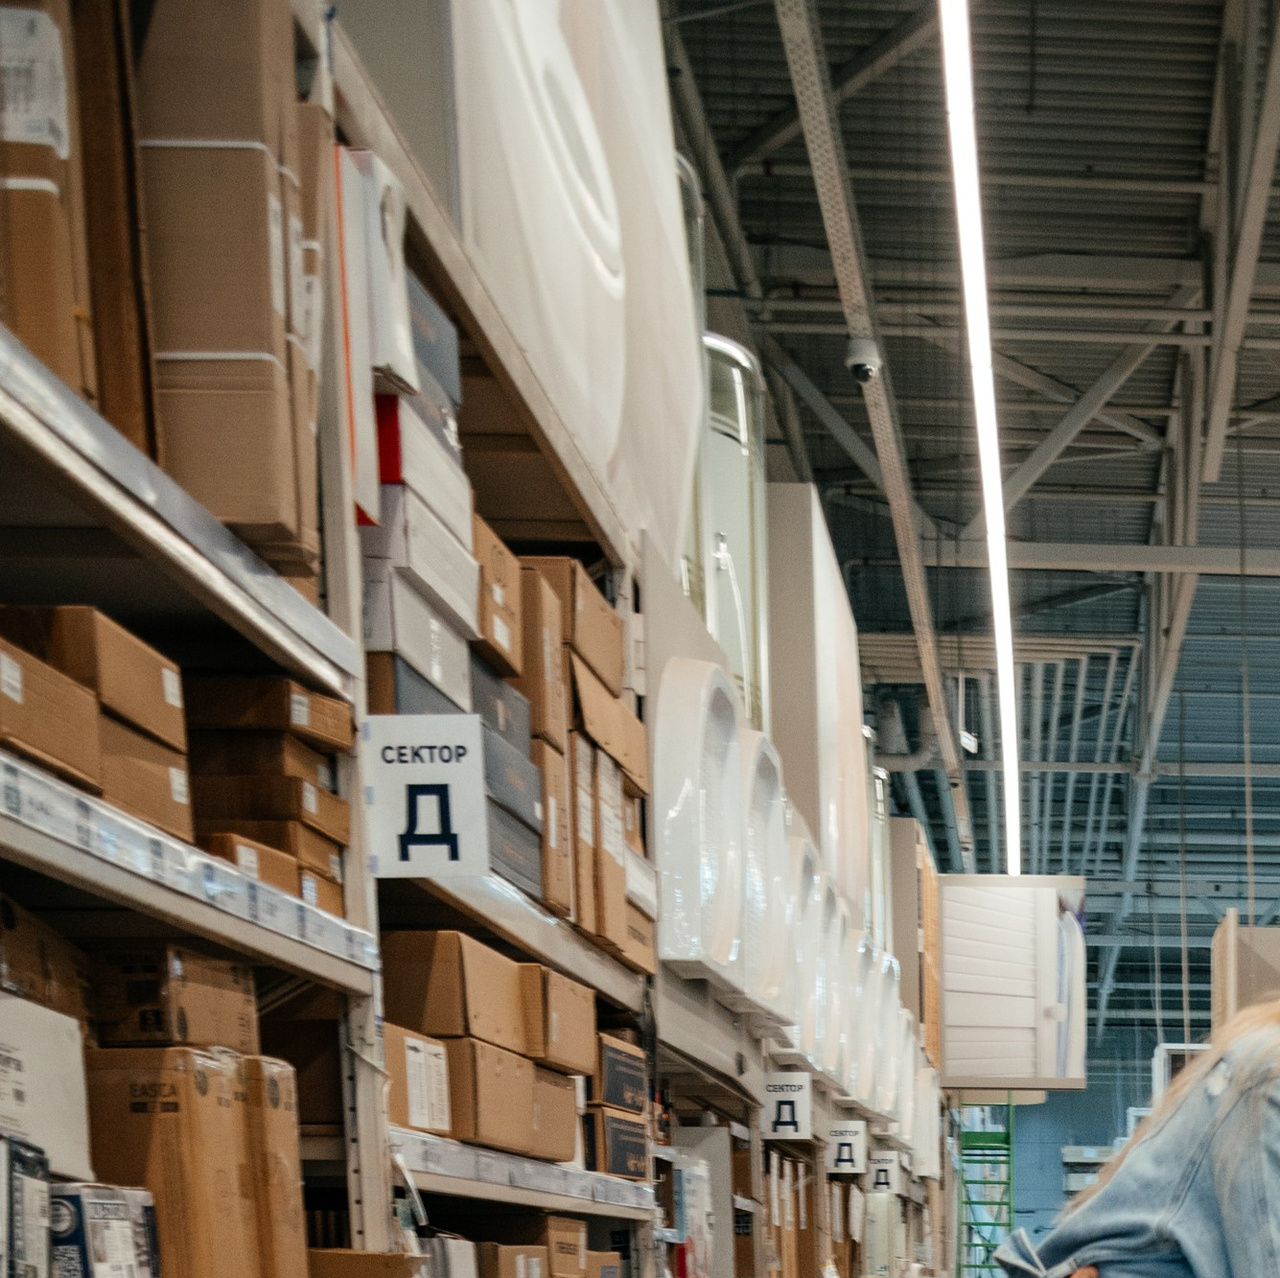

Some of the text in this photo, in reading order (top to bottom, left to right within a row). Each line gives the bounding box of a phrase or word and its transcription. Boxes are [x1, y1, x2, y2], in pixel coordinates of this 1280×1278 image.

[382, 745, 467, 764] СЕКТОР
[397, 783, 460, 861] Д
[766, 1084, 804, 1093] СЕКТОР
[772, 1100, 799, 1132] Д
[834, 1142, 855, 1168] Д
[873, 1169, 890, 1189] Д
